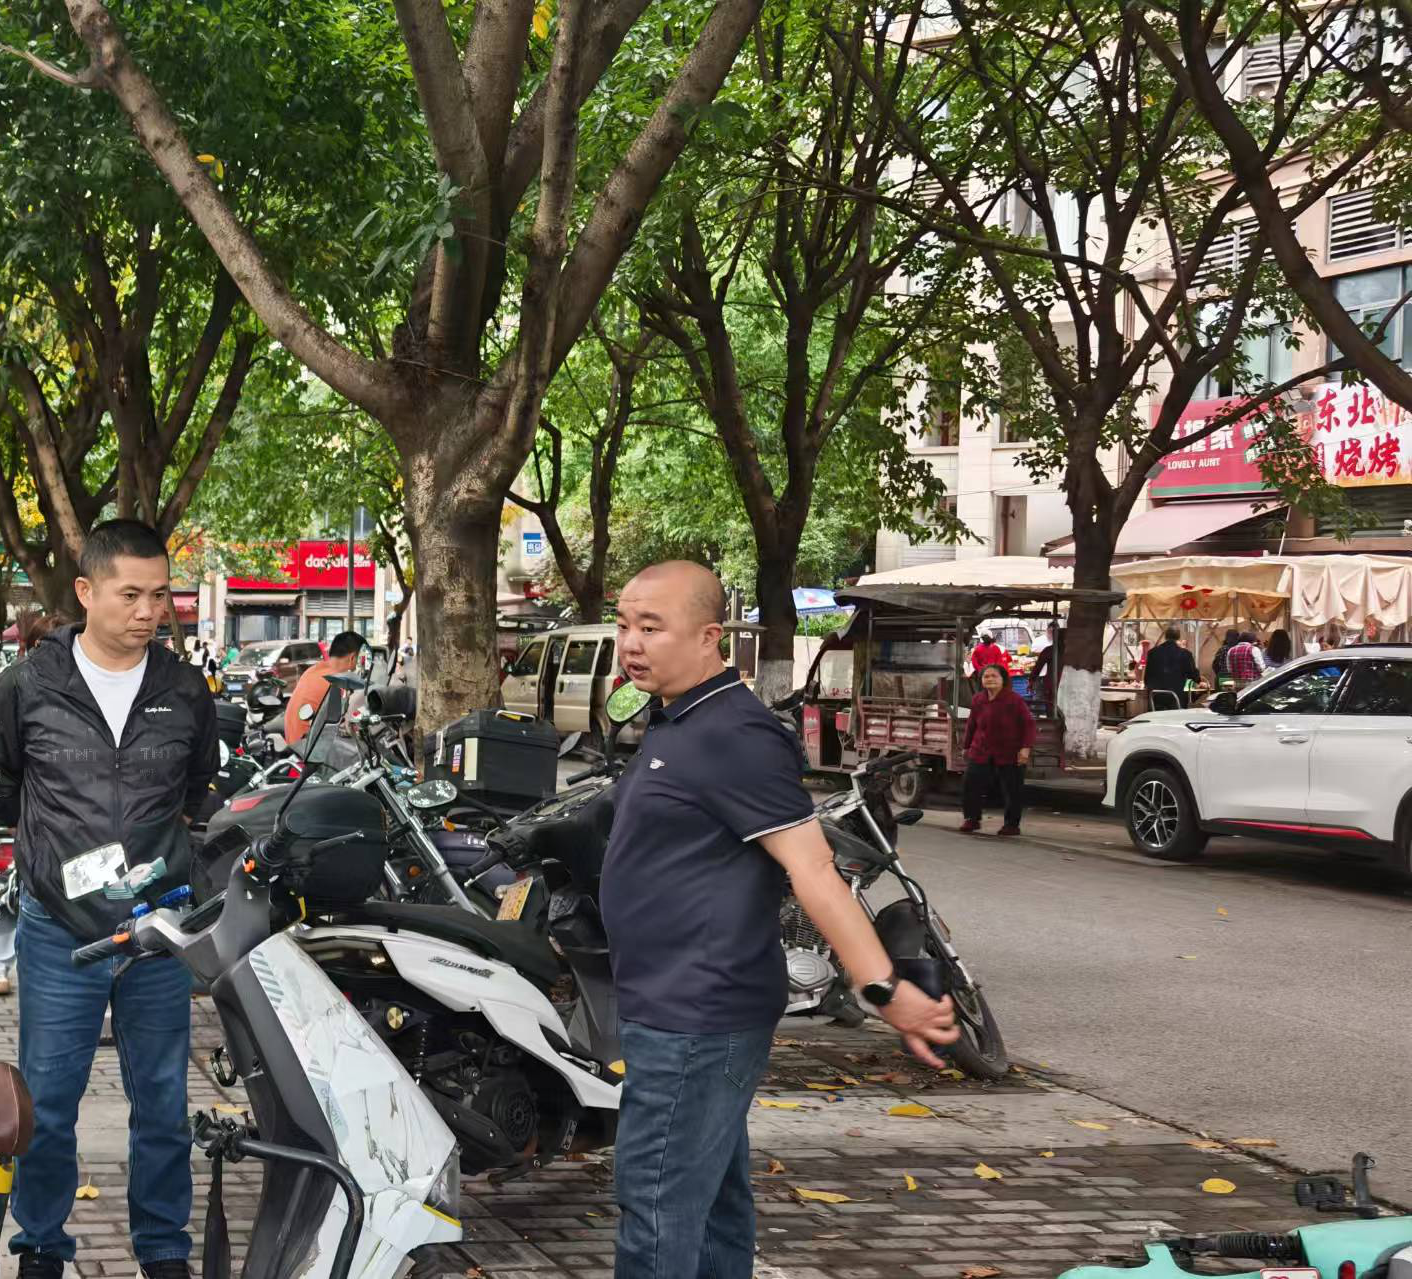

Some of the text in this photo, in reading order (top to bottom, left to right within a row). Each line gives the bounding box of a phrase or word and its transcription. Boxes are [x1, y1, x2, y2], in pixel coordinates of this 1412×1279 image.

[1168, 457, 1221, 470] LOVELY AUNT
[1334, 432, 1401, 478] 烧烤
